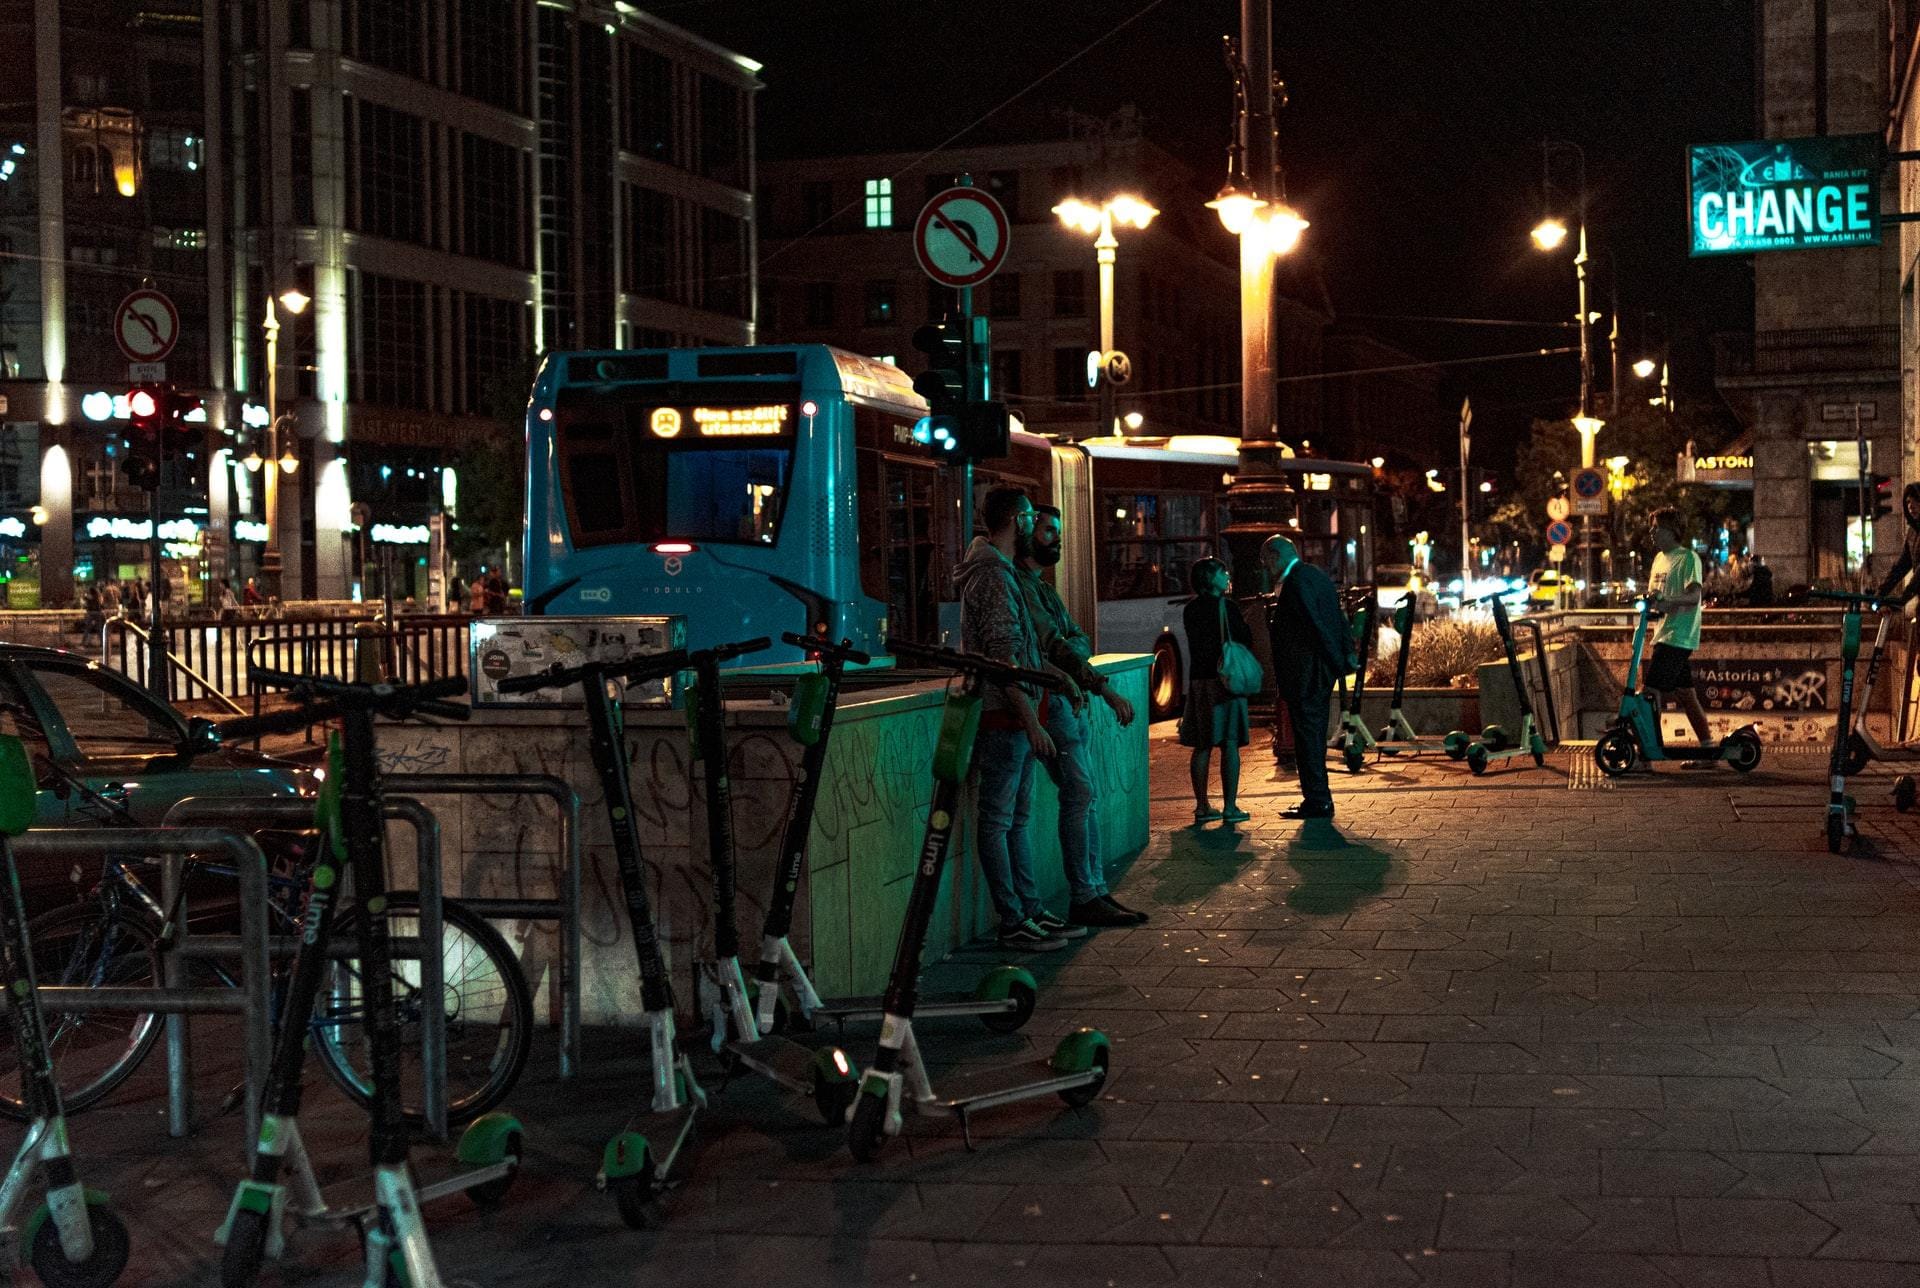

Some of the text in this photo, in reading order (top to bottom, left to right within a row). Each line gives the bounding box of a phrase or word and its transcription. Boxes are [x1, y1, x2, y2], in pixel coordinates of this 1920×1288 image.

[1698, 184, 1871, 239] CHANGE
[1706, 669, 1760, 682] Astoria
[787, 851, 802, 879] Lime
[922, 834, 945, 876] Lime
[303, 892, 331, 945] Lime
